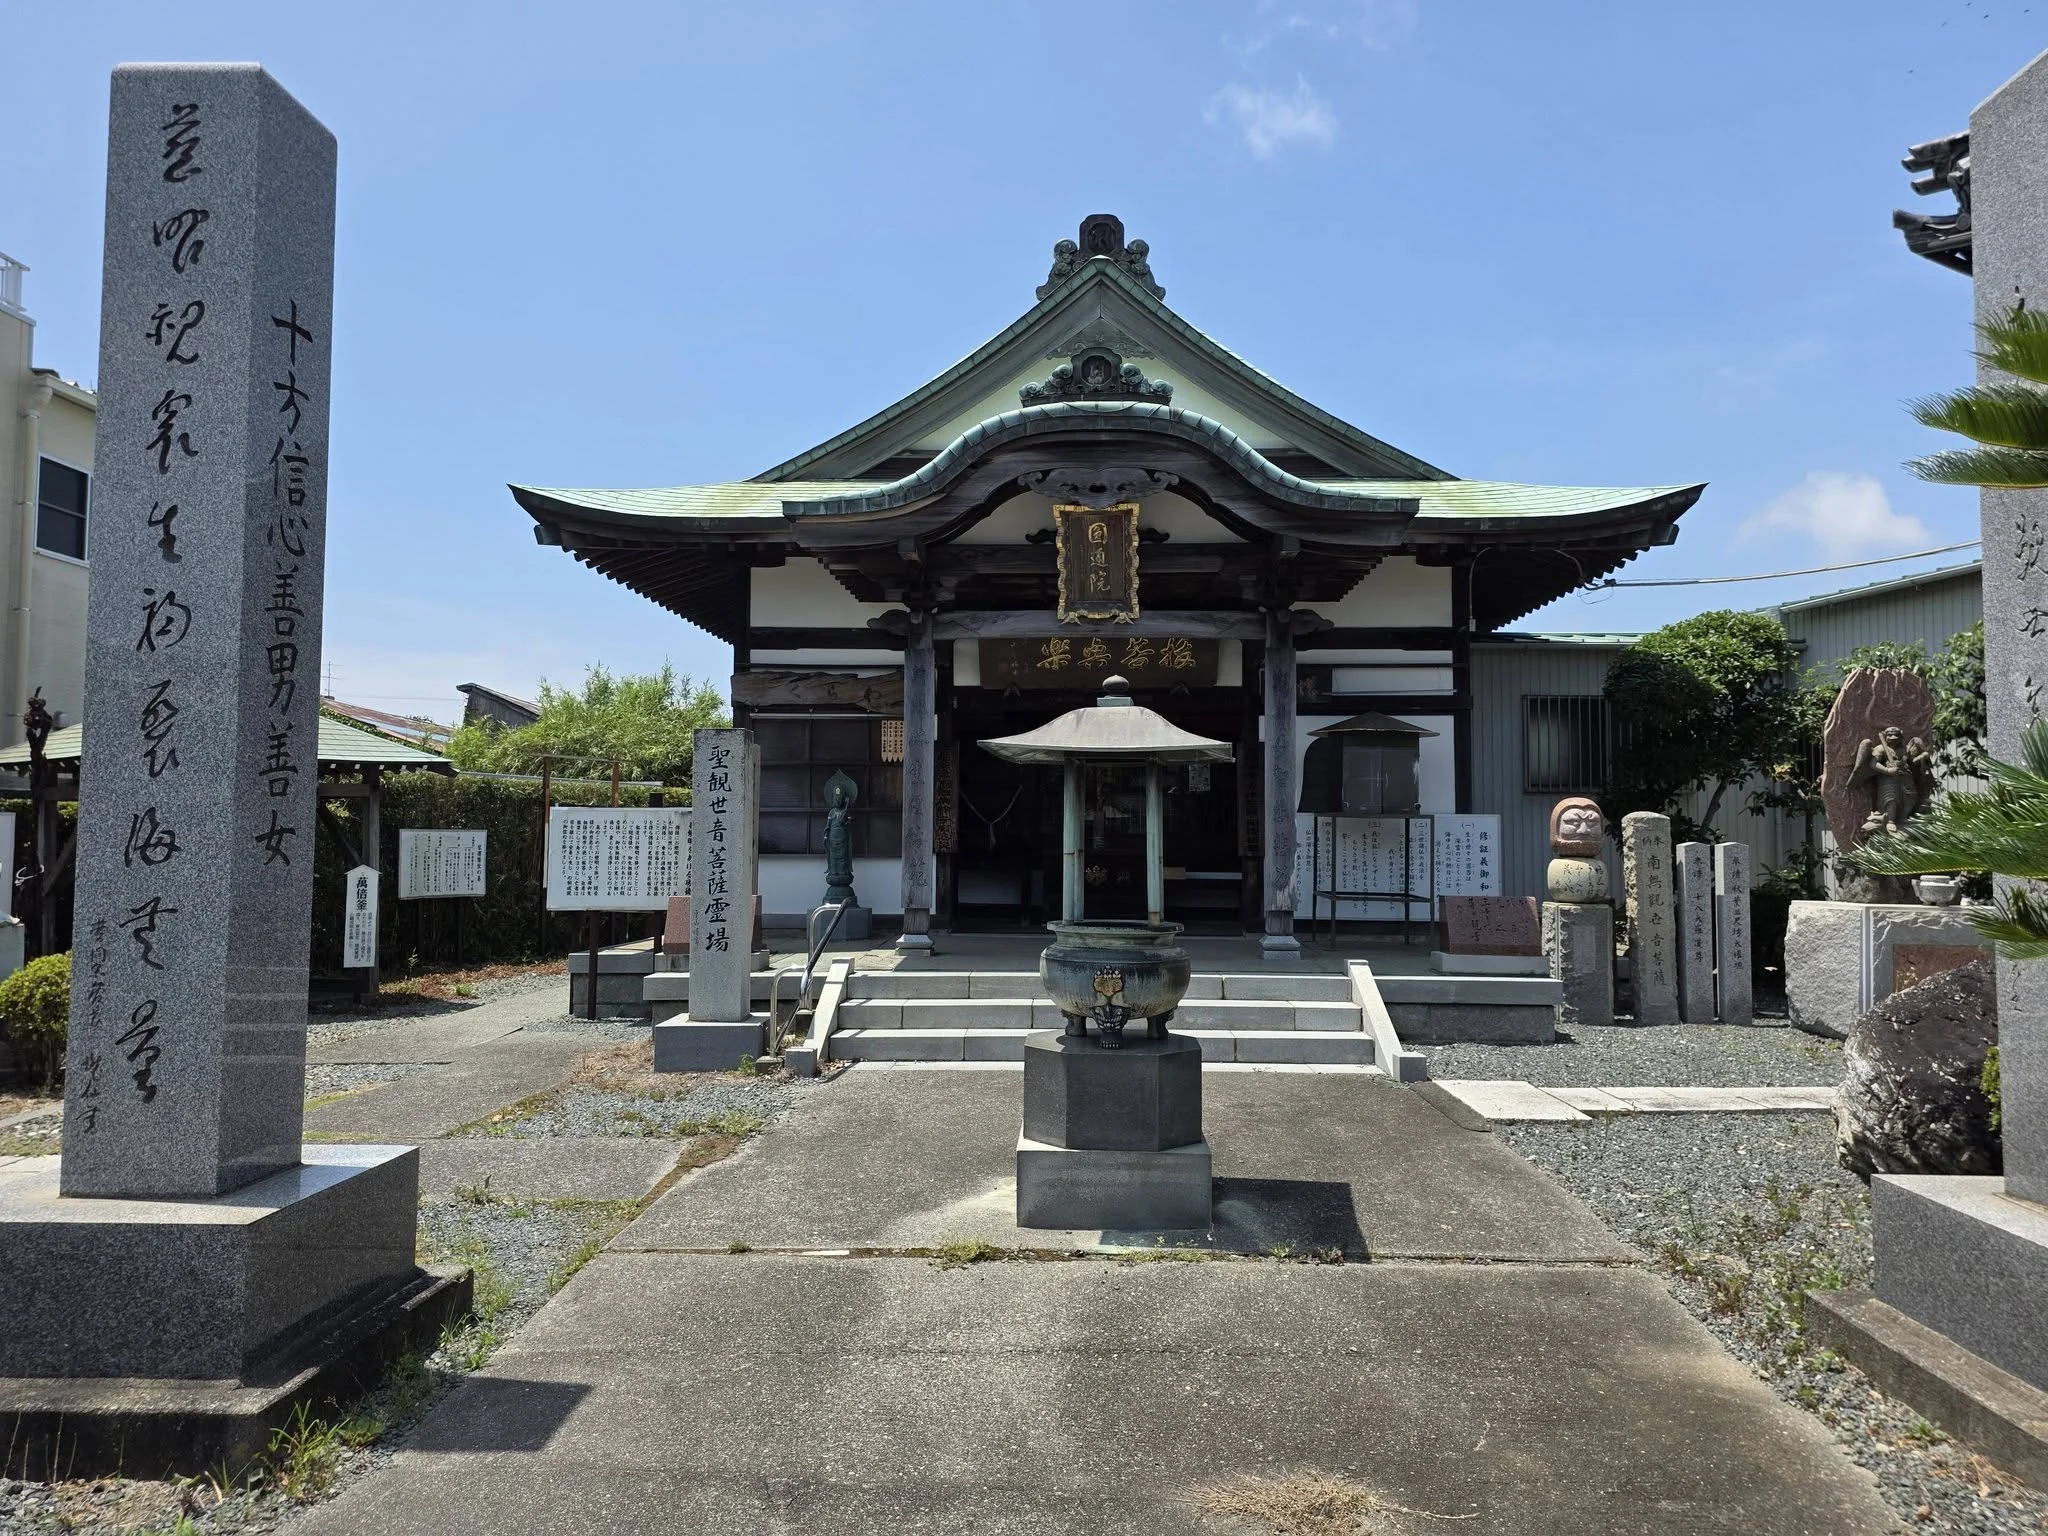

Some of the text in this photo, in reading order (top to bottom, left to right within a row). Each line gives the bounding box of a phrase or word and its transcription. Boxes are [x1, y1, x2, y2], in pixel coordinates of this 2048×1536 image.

[254, 298, 314, 868] 十方信心善男善女
[704, 745, 732, 953] 聖観世音菩薩霊場
